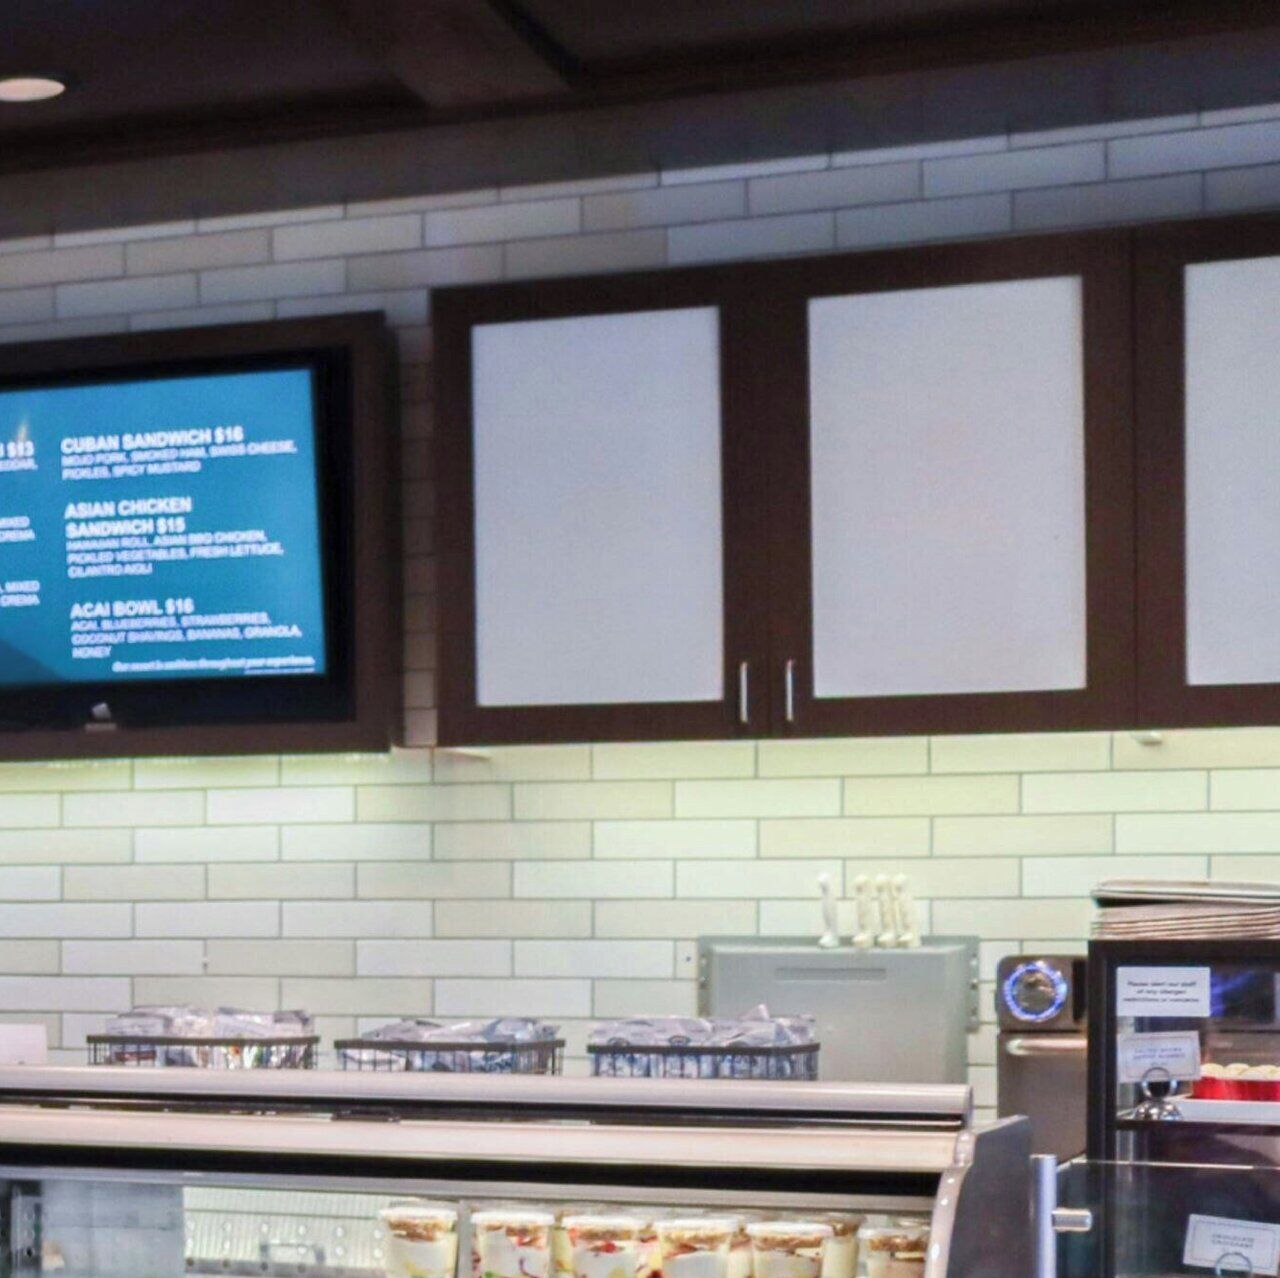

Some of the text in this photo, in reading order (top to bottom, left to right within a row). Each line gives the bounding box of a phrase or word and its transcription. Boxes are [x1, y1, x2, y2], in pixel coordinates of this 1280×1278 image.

[61, 434, 119, 453] CUBAN
[122, 428, 212, 451] SANDWICH
[64, 496, 192, 519] ASIAN CHICKEN
[66, 517, 185, 539] SANDWICH $15
[70, 602, 110, 619] ACAI
[112, 599, 163, 617] BOWL
